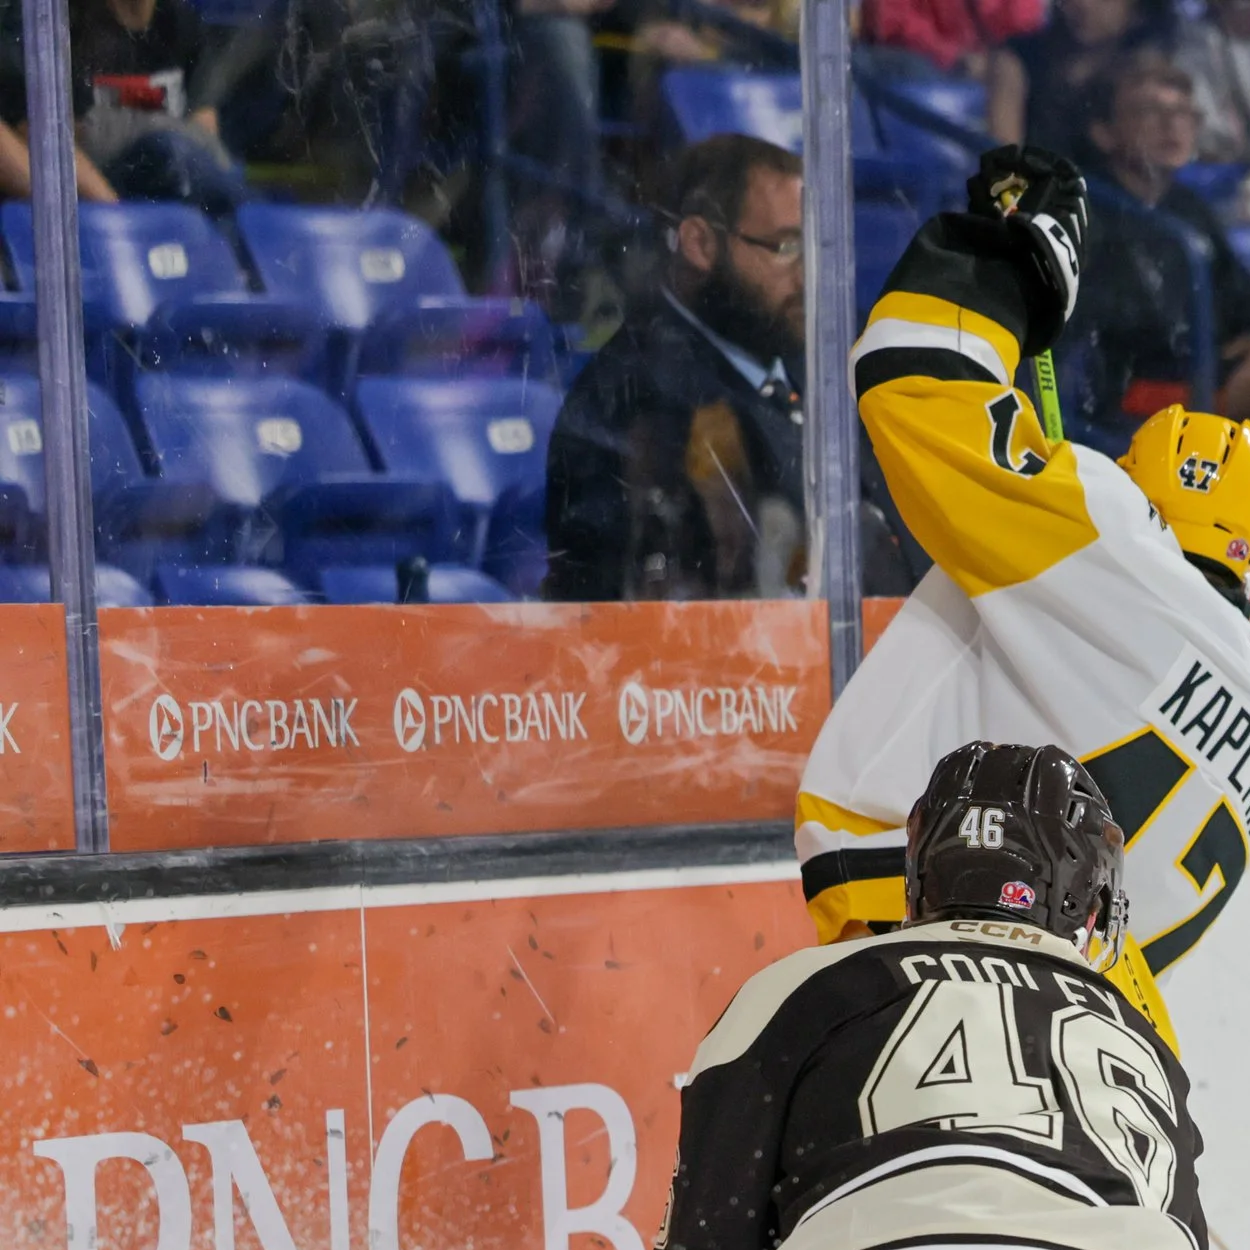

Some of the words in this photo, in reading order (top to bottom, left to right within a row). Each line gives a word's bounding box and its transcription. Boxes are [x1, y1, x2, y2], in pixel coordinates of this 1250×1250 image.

[1178, 456, 1219, 494] 47
[958, 805, 1006, 850] 46
[950, 921, 1043, 945] CCM
[858, 979, 1178, 1214] 46
